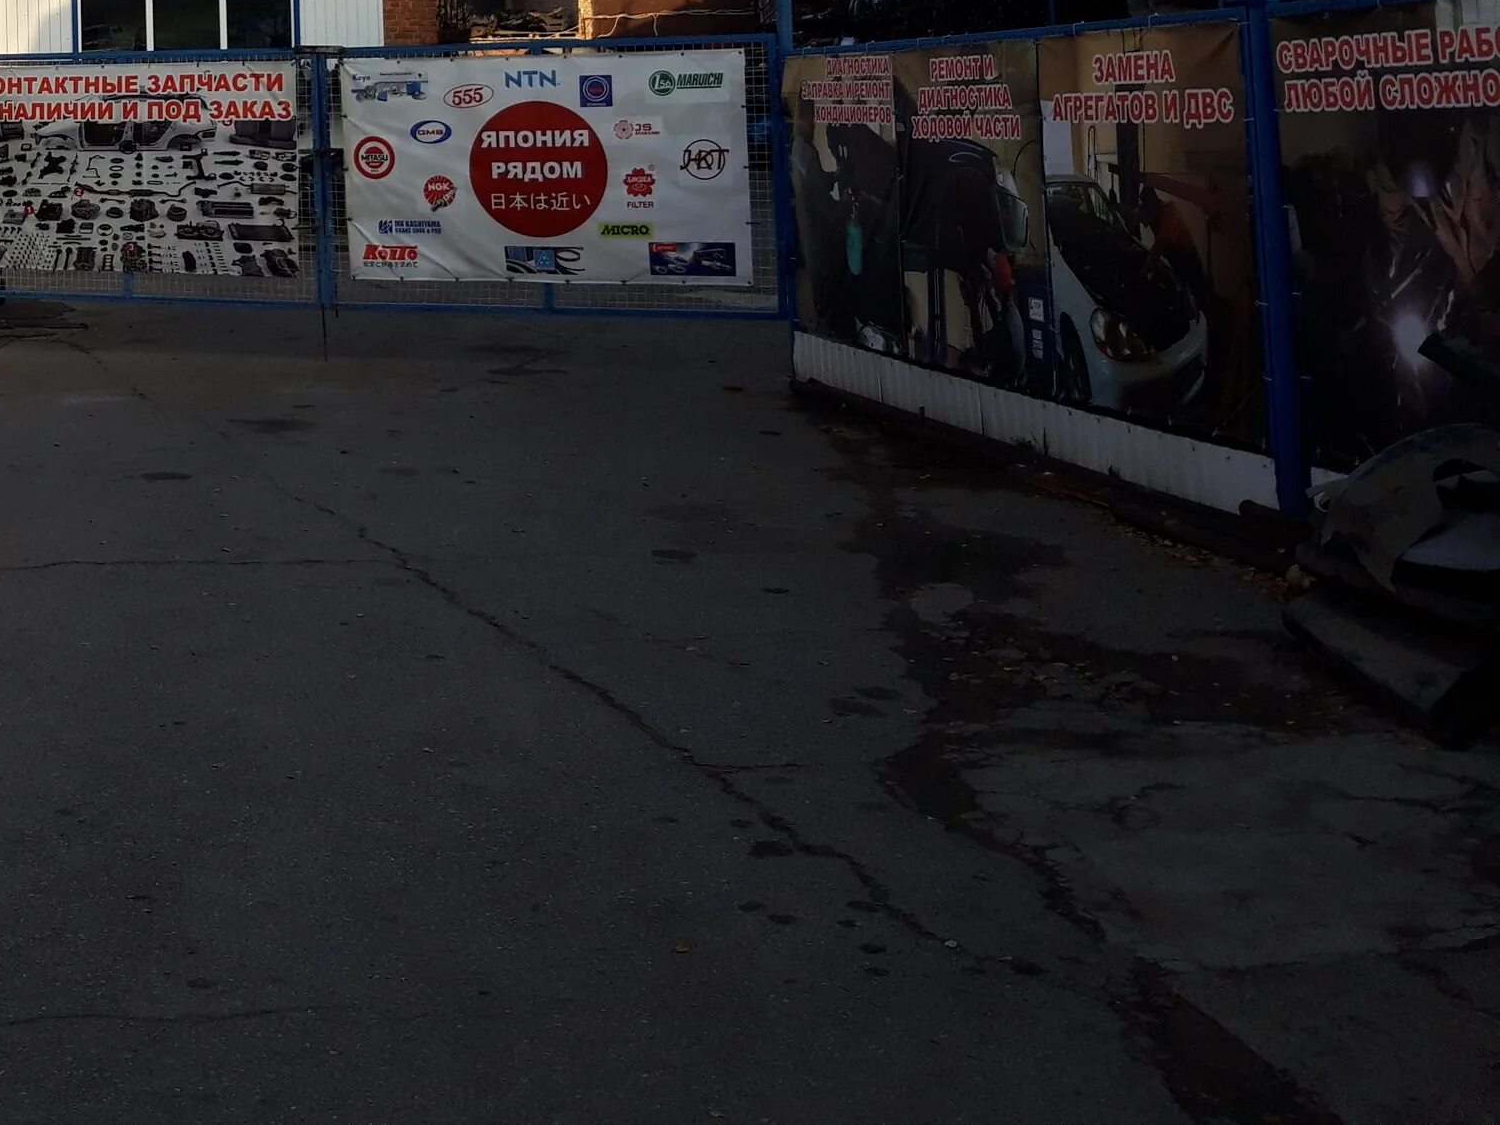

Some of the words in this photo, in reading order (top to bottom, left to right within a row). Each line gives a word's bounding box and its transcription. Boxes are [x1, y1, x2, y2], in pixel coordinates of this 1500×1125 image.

[1278, 33, 1431, 70] СВАРОЧНЫЕ
[826, 57, 890, 75] ДИАГНОСТИКА
[930, 59, 980, 79] РЕМОНТ
[984, 57, 993, 78] И
[1094, 51, 1173, 82] ЗАМЕНА
[147, 73, 283, 93] ЗАПЧАСТИ
[505, 70, 556, 88] NTN
[677, 73, 724, 86] MARUICHI
[452, 87, 484, 106] 555
[802, 83, 845, 99] ЗАПРАВКА
[846, 83, 853, 98] И
[854, 82, 890, 97] РЕМОНТ
[919, 87, 1011, 113] ДИАГНОСТИКА
[1287, 71, 1373, 110] ЛЮБОЙ
[122, 101, 139, 120] И
[147, 100, 202, 122] ПОД
[209, 100, 293, 120] ЗАКАЗ
[815, 106, 891, 124] КОНДИЦИОНЕРОВ
[1054, 94, 1157, 121] АГРЕГАТОВ
[1165, 93, 1178, 120] И
[1185, 91, 1232, 126] ДВС
[912, 115, 971, 140] ХОДОВОЙ
[975, 115, 1020, 138] ЧАСТИ
[481, 129, 590, 148] ЯПОНИЯ
[491, 161, 582, 182] РЯДОМ
[428, 183, 450, 191] NGK
[491, 192, 591, 211] 日本は近い
[601, 225, 650, 235] MICRO
